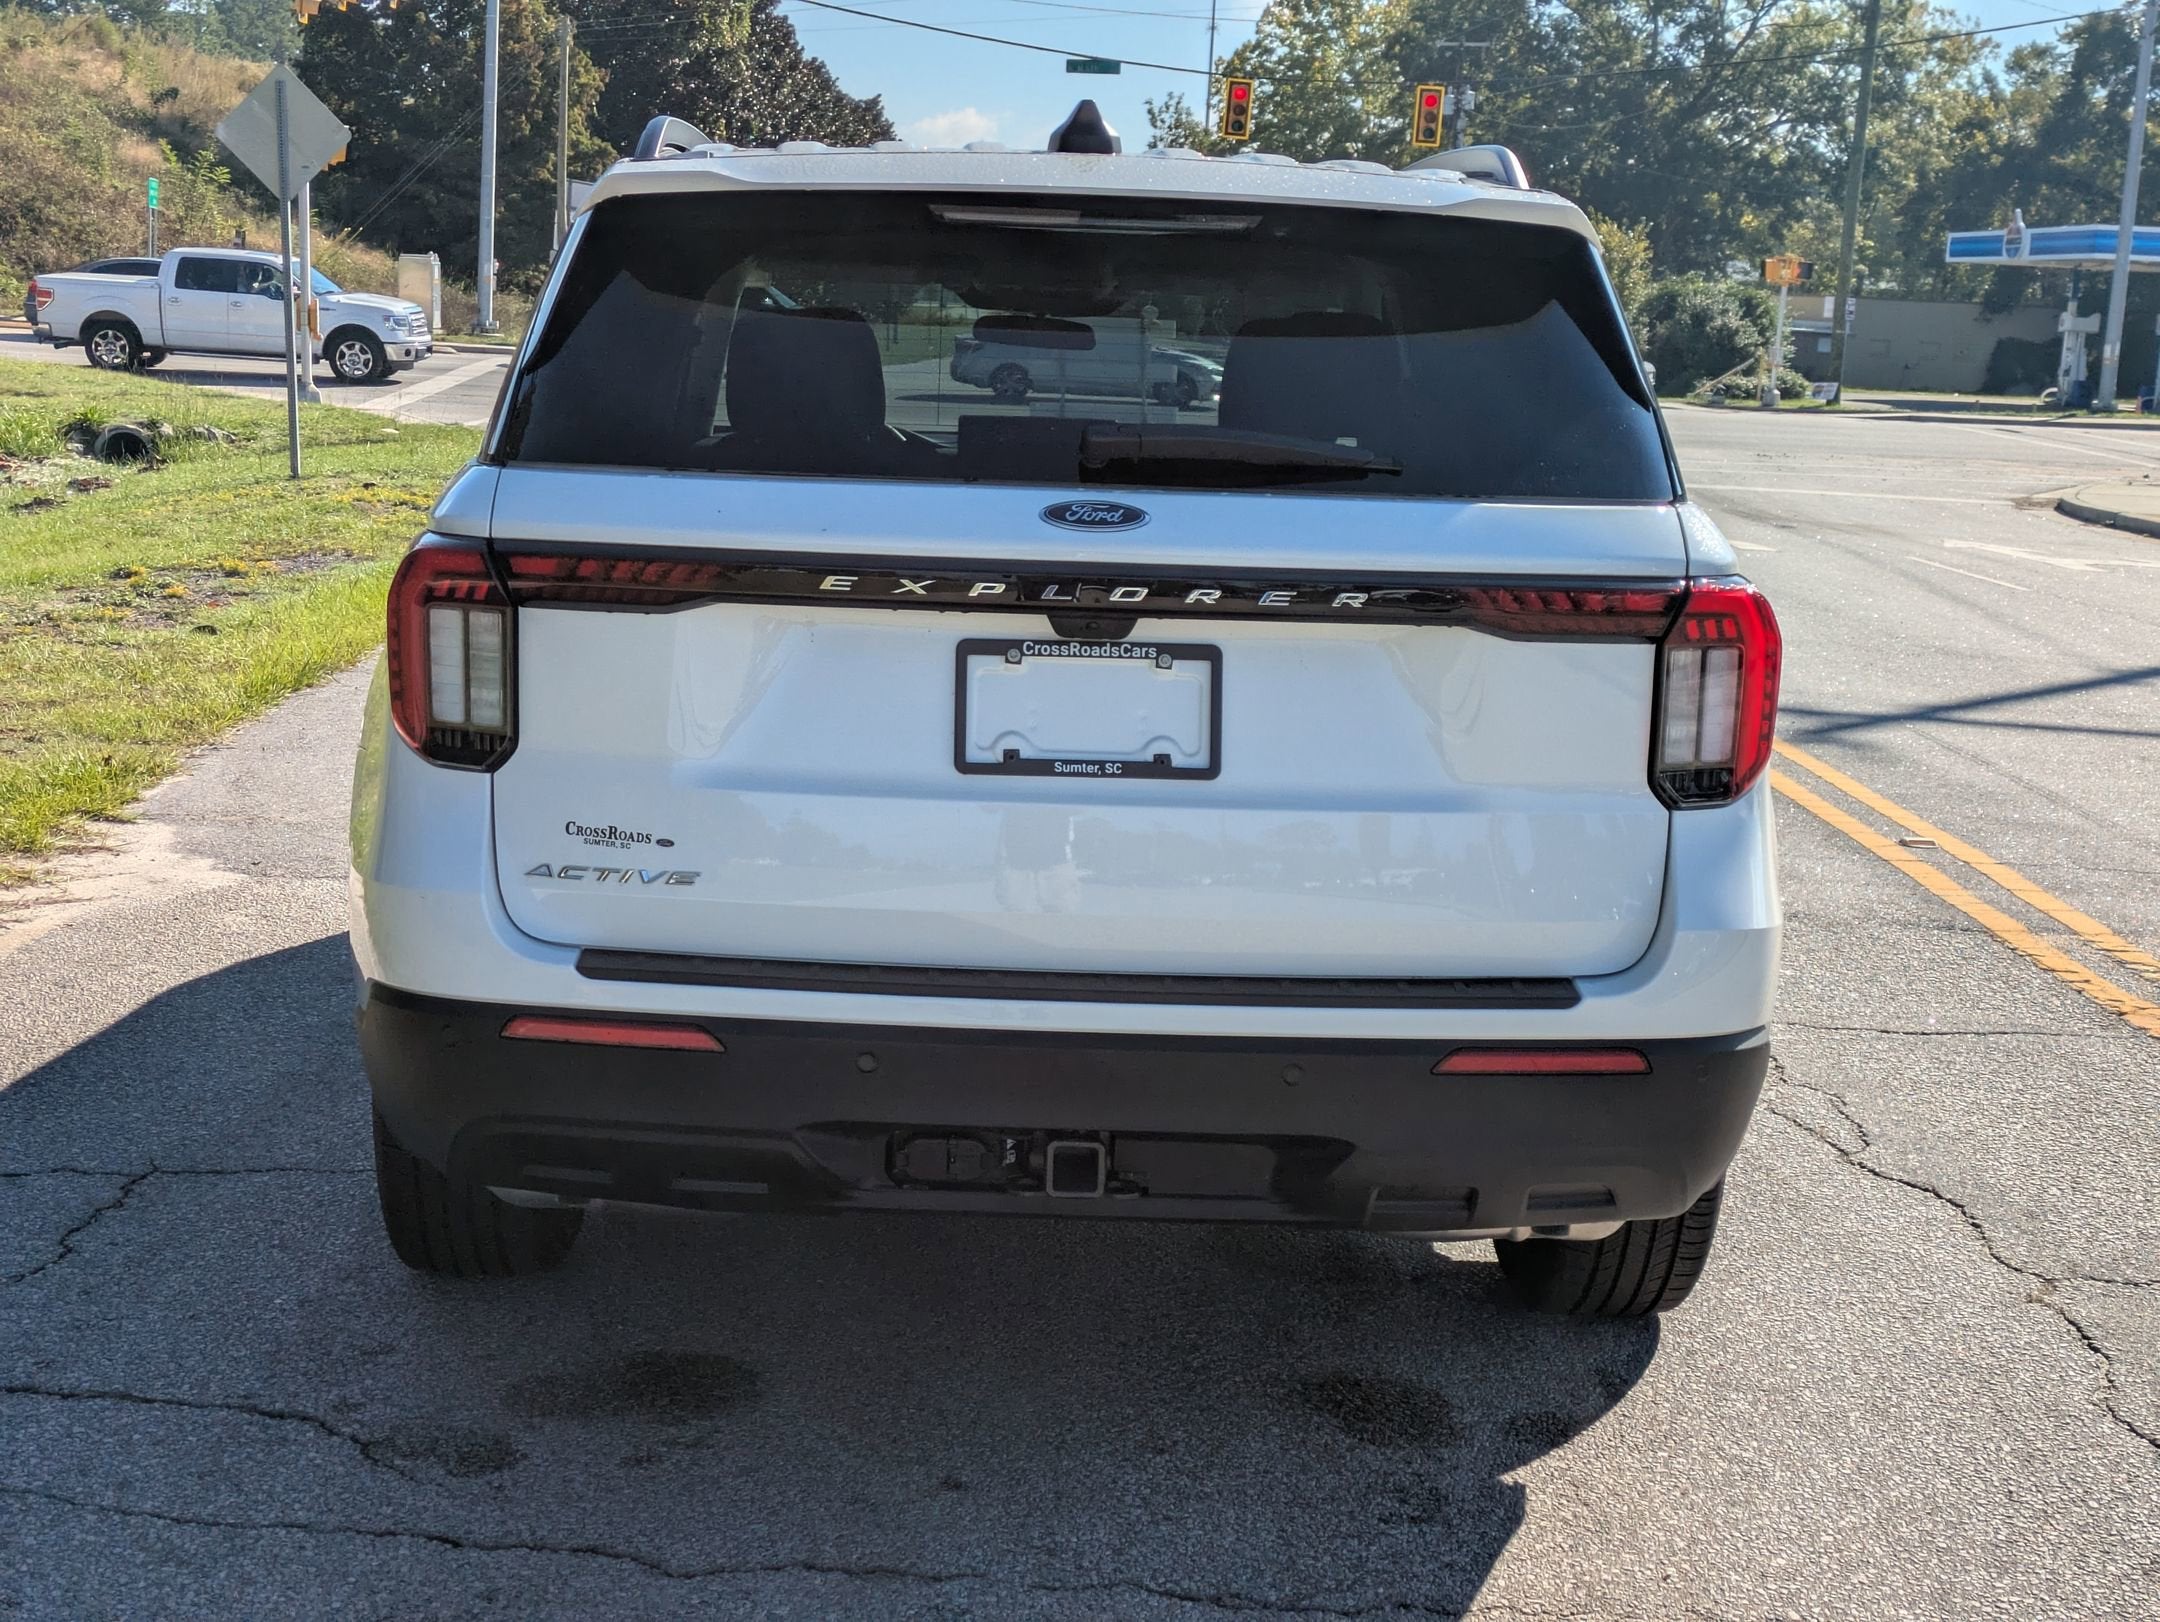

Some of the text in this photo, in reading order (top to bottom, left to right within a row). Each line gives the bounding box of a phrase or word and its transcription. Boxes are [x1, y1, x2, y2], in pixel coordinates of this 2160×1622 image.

[1065, 503, 1125, 523] Ford
[818, 575, 1369, 608] EXPLORER
[1022, 641, 1158, 658] CrossRoadsCars
[1054, 761, 1122, 775] Sumter, SC
[583, 837, 632, 850] SUMTER, SC
[524, 863, 702, 886] ACTIVE
